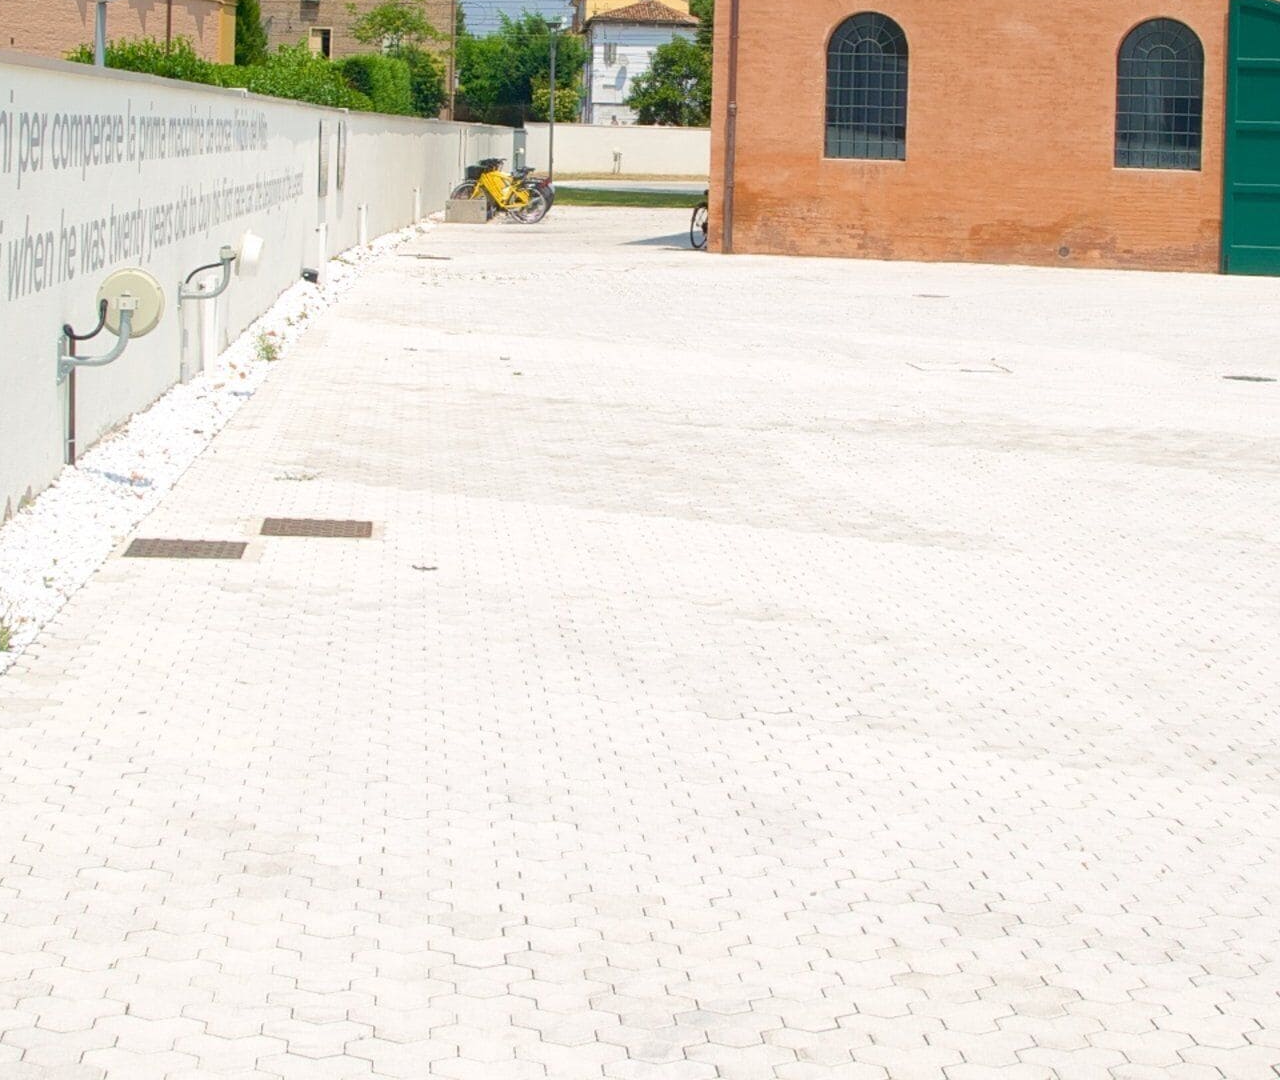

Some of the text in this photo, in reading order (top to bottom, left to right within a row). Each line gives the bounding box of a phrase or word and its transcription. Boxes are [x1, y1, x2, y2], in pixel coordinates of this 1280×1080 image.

[16, 111, 48, 190] per
[51, 113, 123, 181] comperare
[126, 99, 136, 162] la
[7, 214, 54, 302] when
[57, 208, 77, 283] he
[80, 218, 106, 274] was
[109, 198, 147, 265] twenty
[147, 203, 173, 263] years
